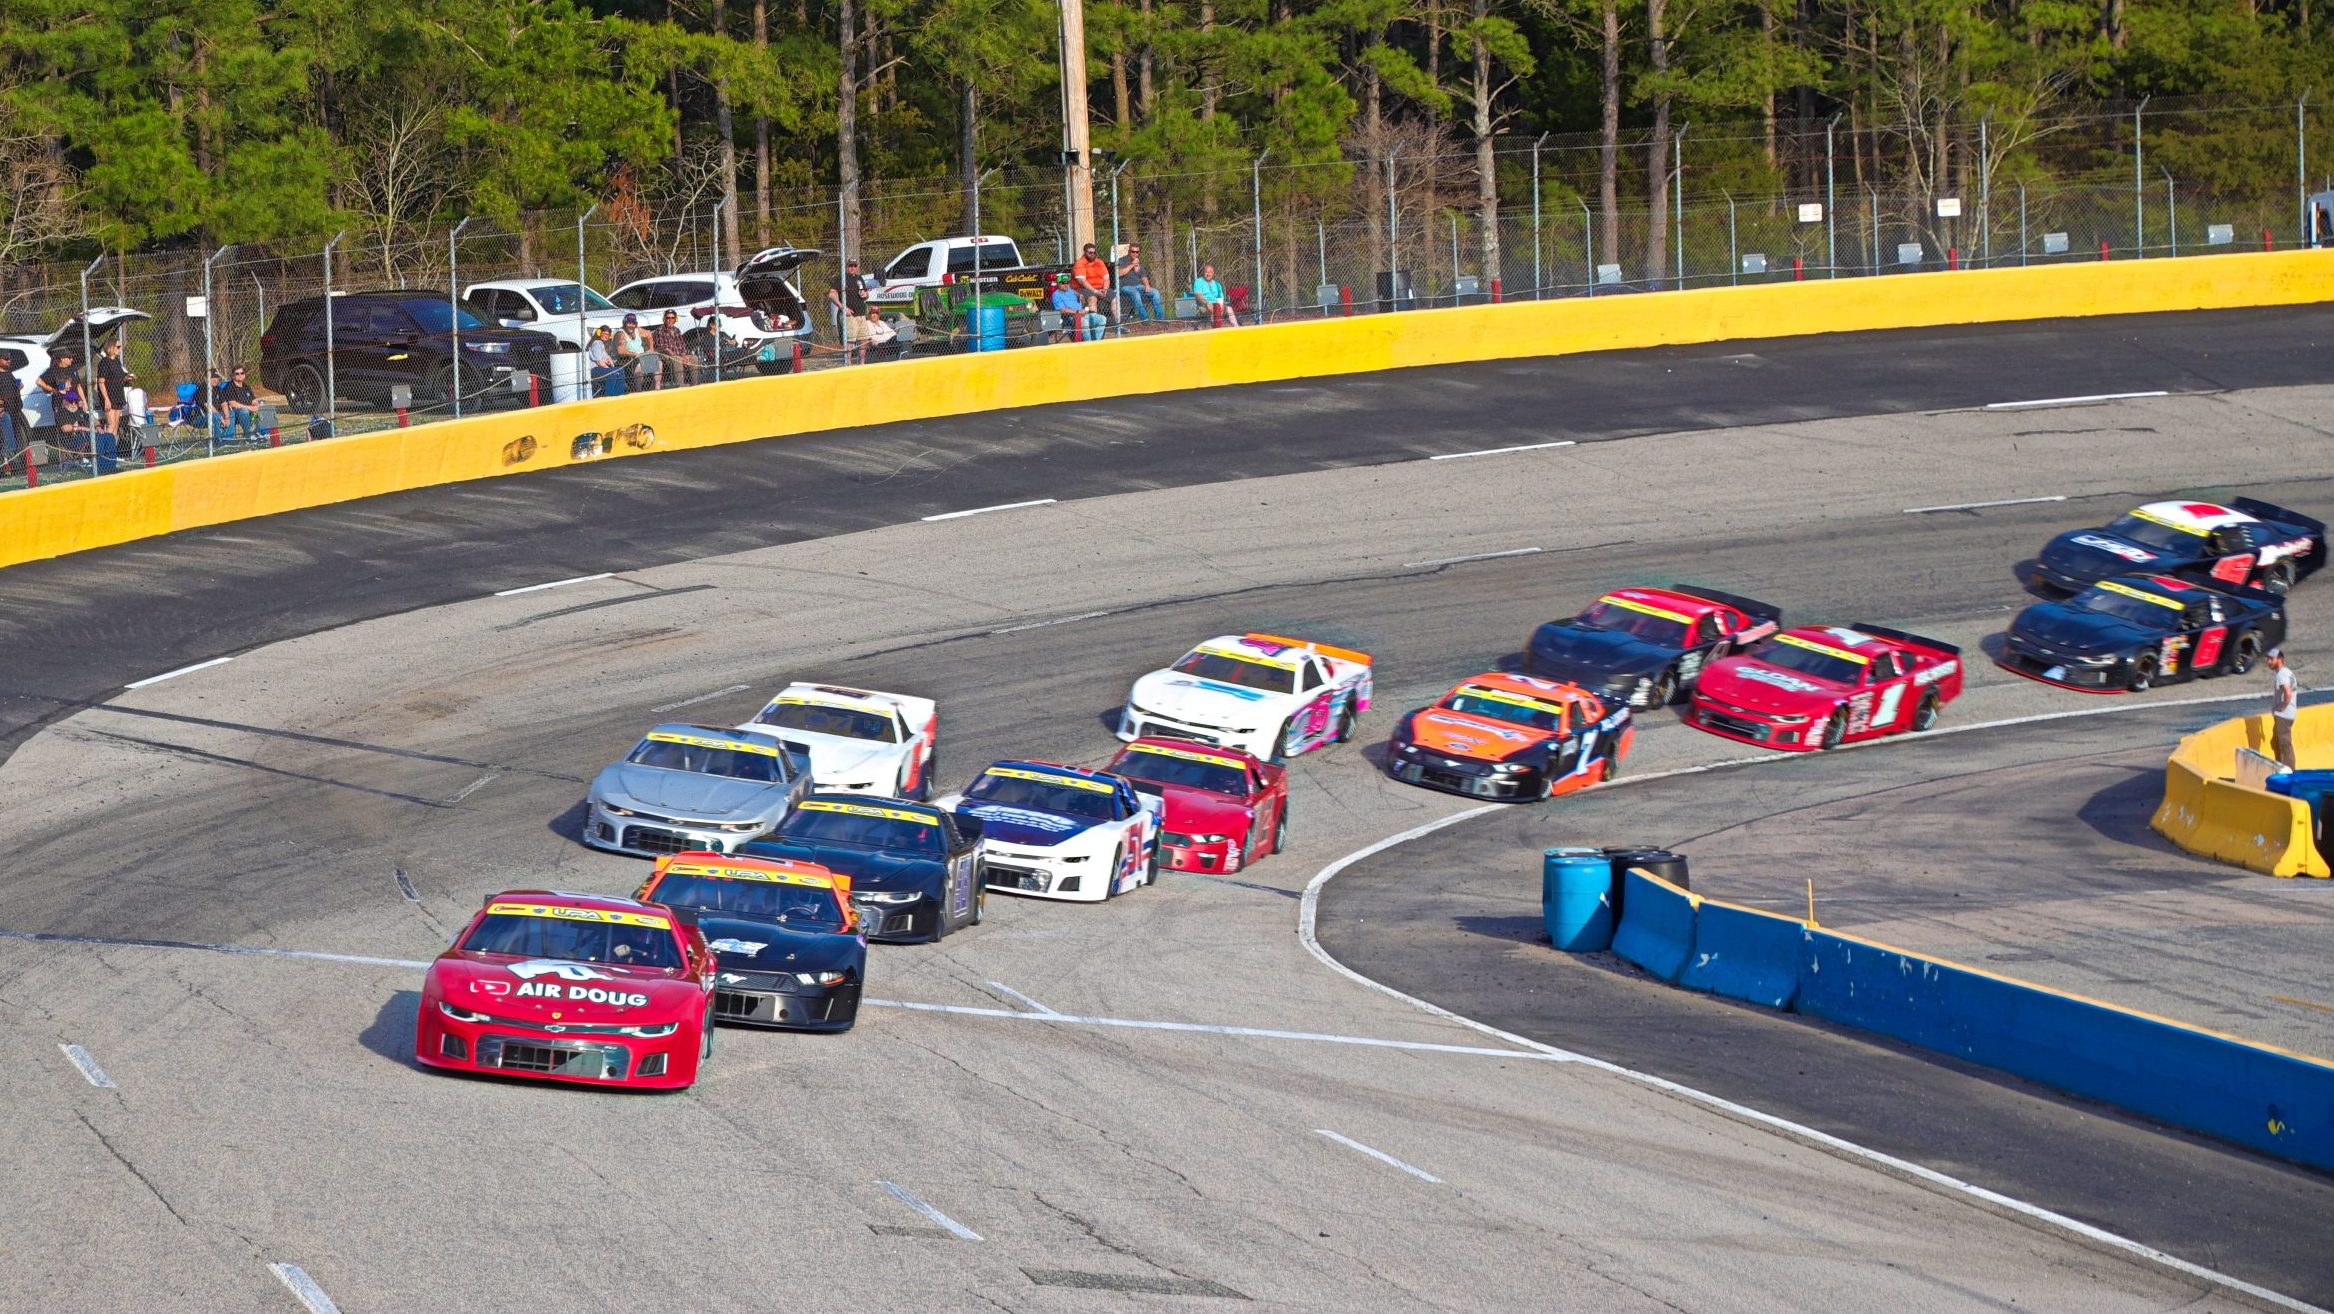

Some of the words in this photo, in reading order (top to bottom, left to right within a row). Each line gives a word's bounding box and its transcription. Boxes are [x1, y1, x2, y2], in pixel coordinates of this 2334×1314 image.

[1870, 682, 1906, 728] 1
[1576, 728, 1600, 776] 7
[516, 982, 562, 998] AIR
[568, 985, 649, 1007] DOUG
